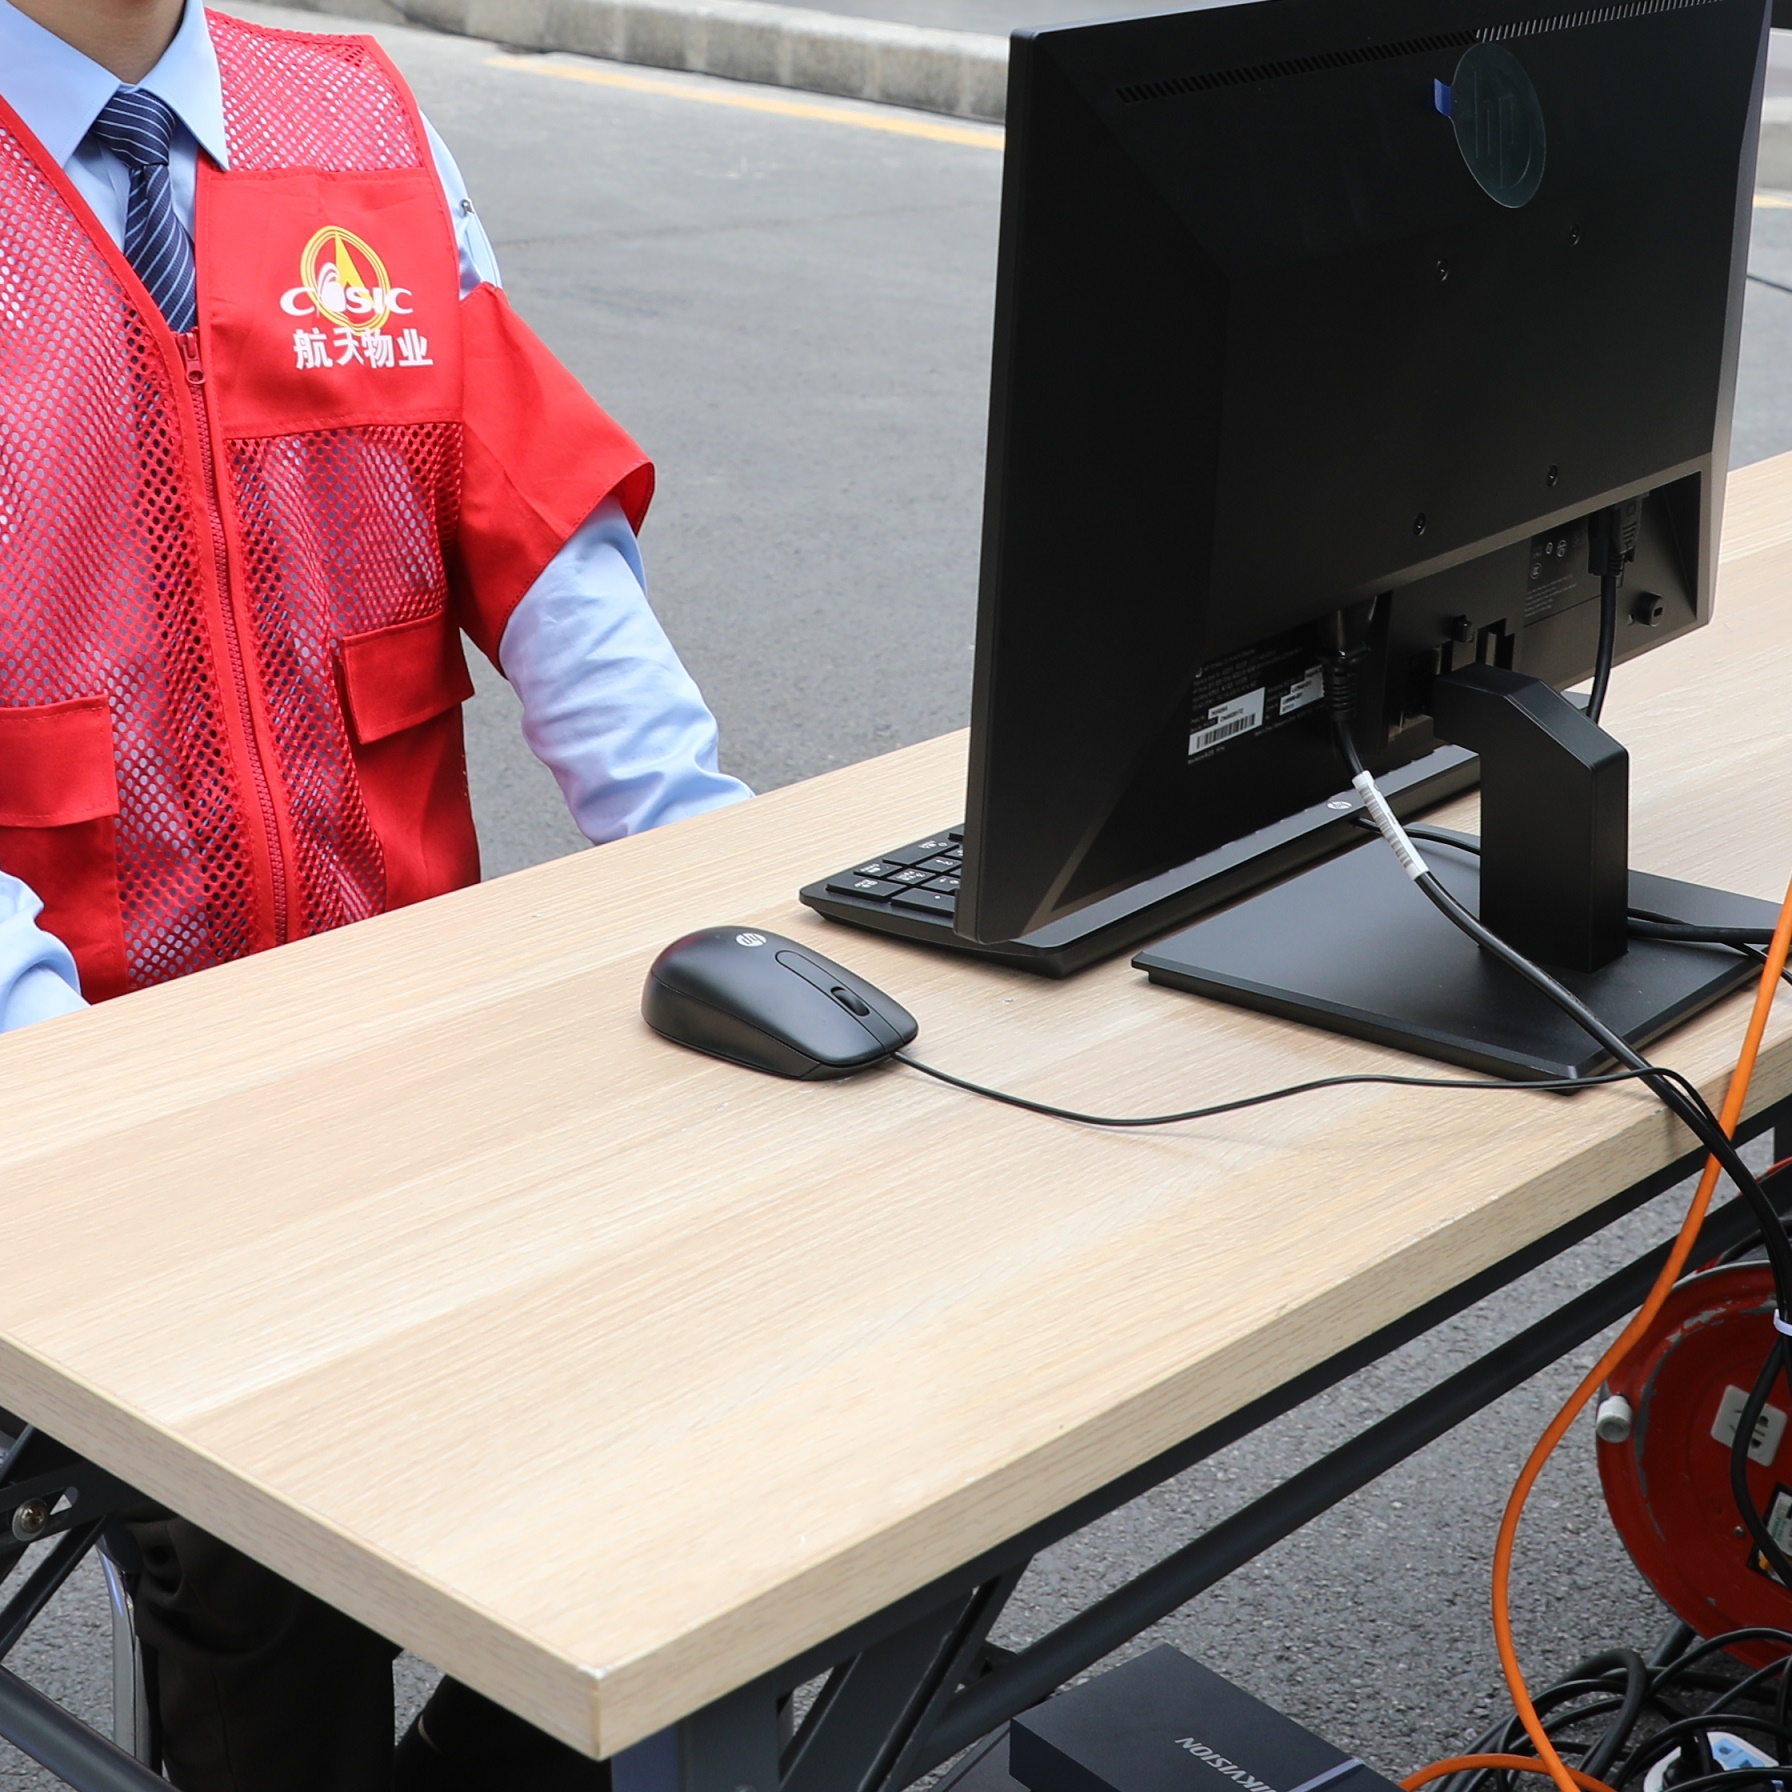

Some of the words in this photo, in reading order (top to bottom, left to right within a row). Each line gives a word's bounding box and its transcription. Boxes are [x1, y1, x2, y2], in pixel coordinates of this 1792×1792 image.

[293, 326, 434, 370] 航天物业
[1173, 1736, 1278, 1792] IKVISION
